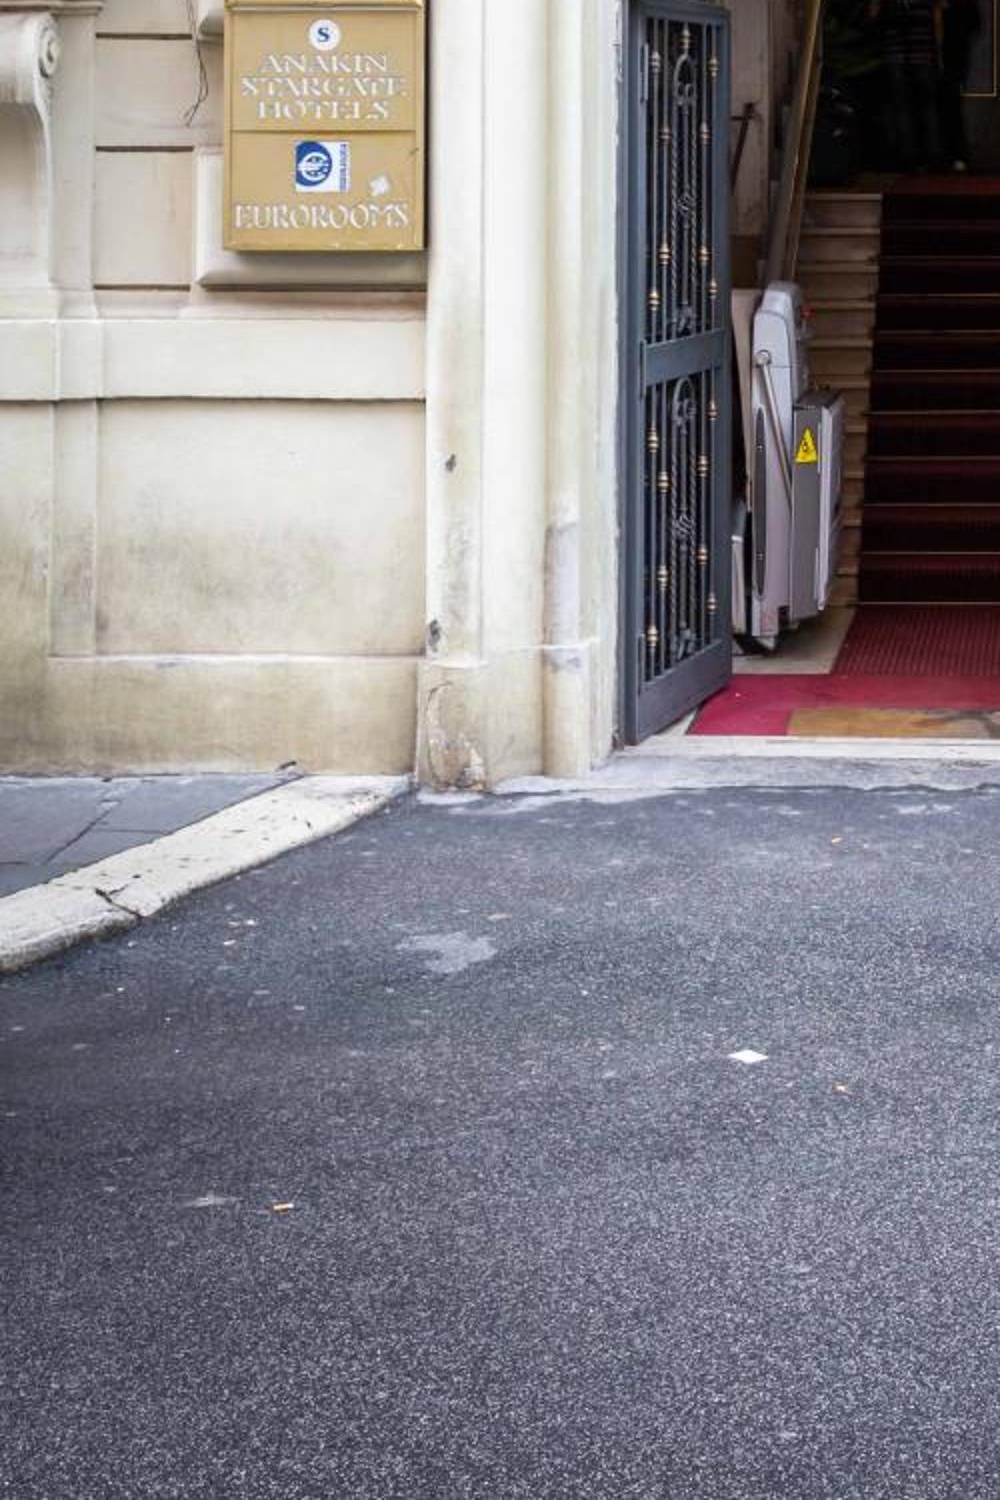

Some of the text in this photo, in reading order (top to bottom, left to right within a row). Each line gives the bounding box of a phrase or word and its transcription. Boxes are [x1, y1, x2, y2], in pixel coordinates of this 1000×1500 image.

[260, 55, 388, 74] ANAKIN
[241, 76, 406, 98] STARGATE
[258, 100, 389, 120] HOTELS
[233, 203, 409, 229] EUROROOMS
